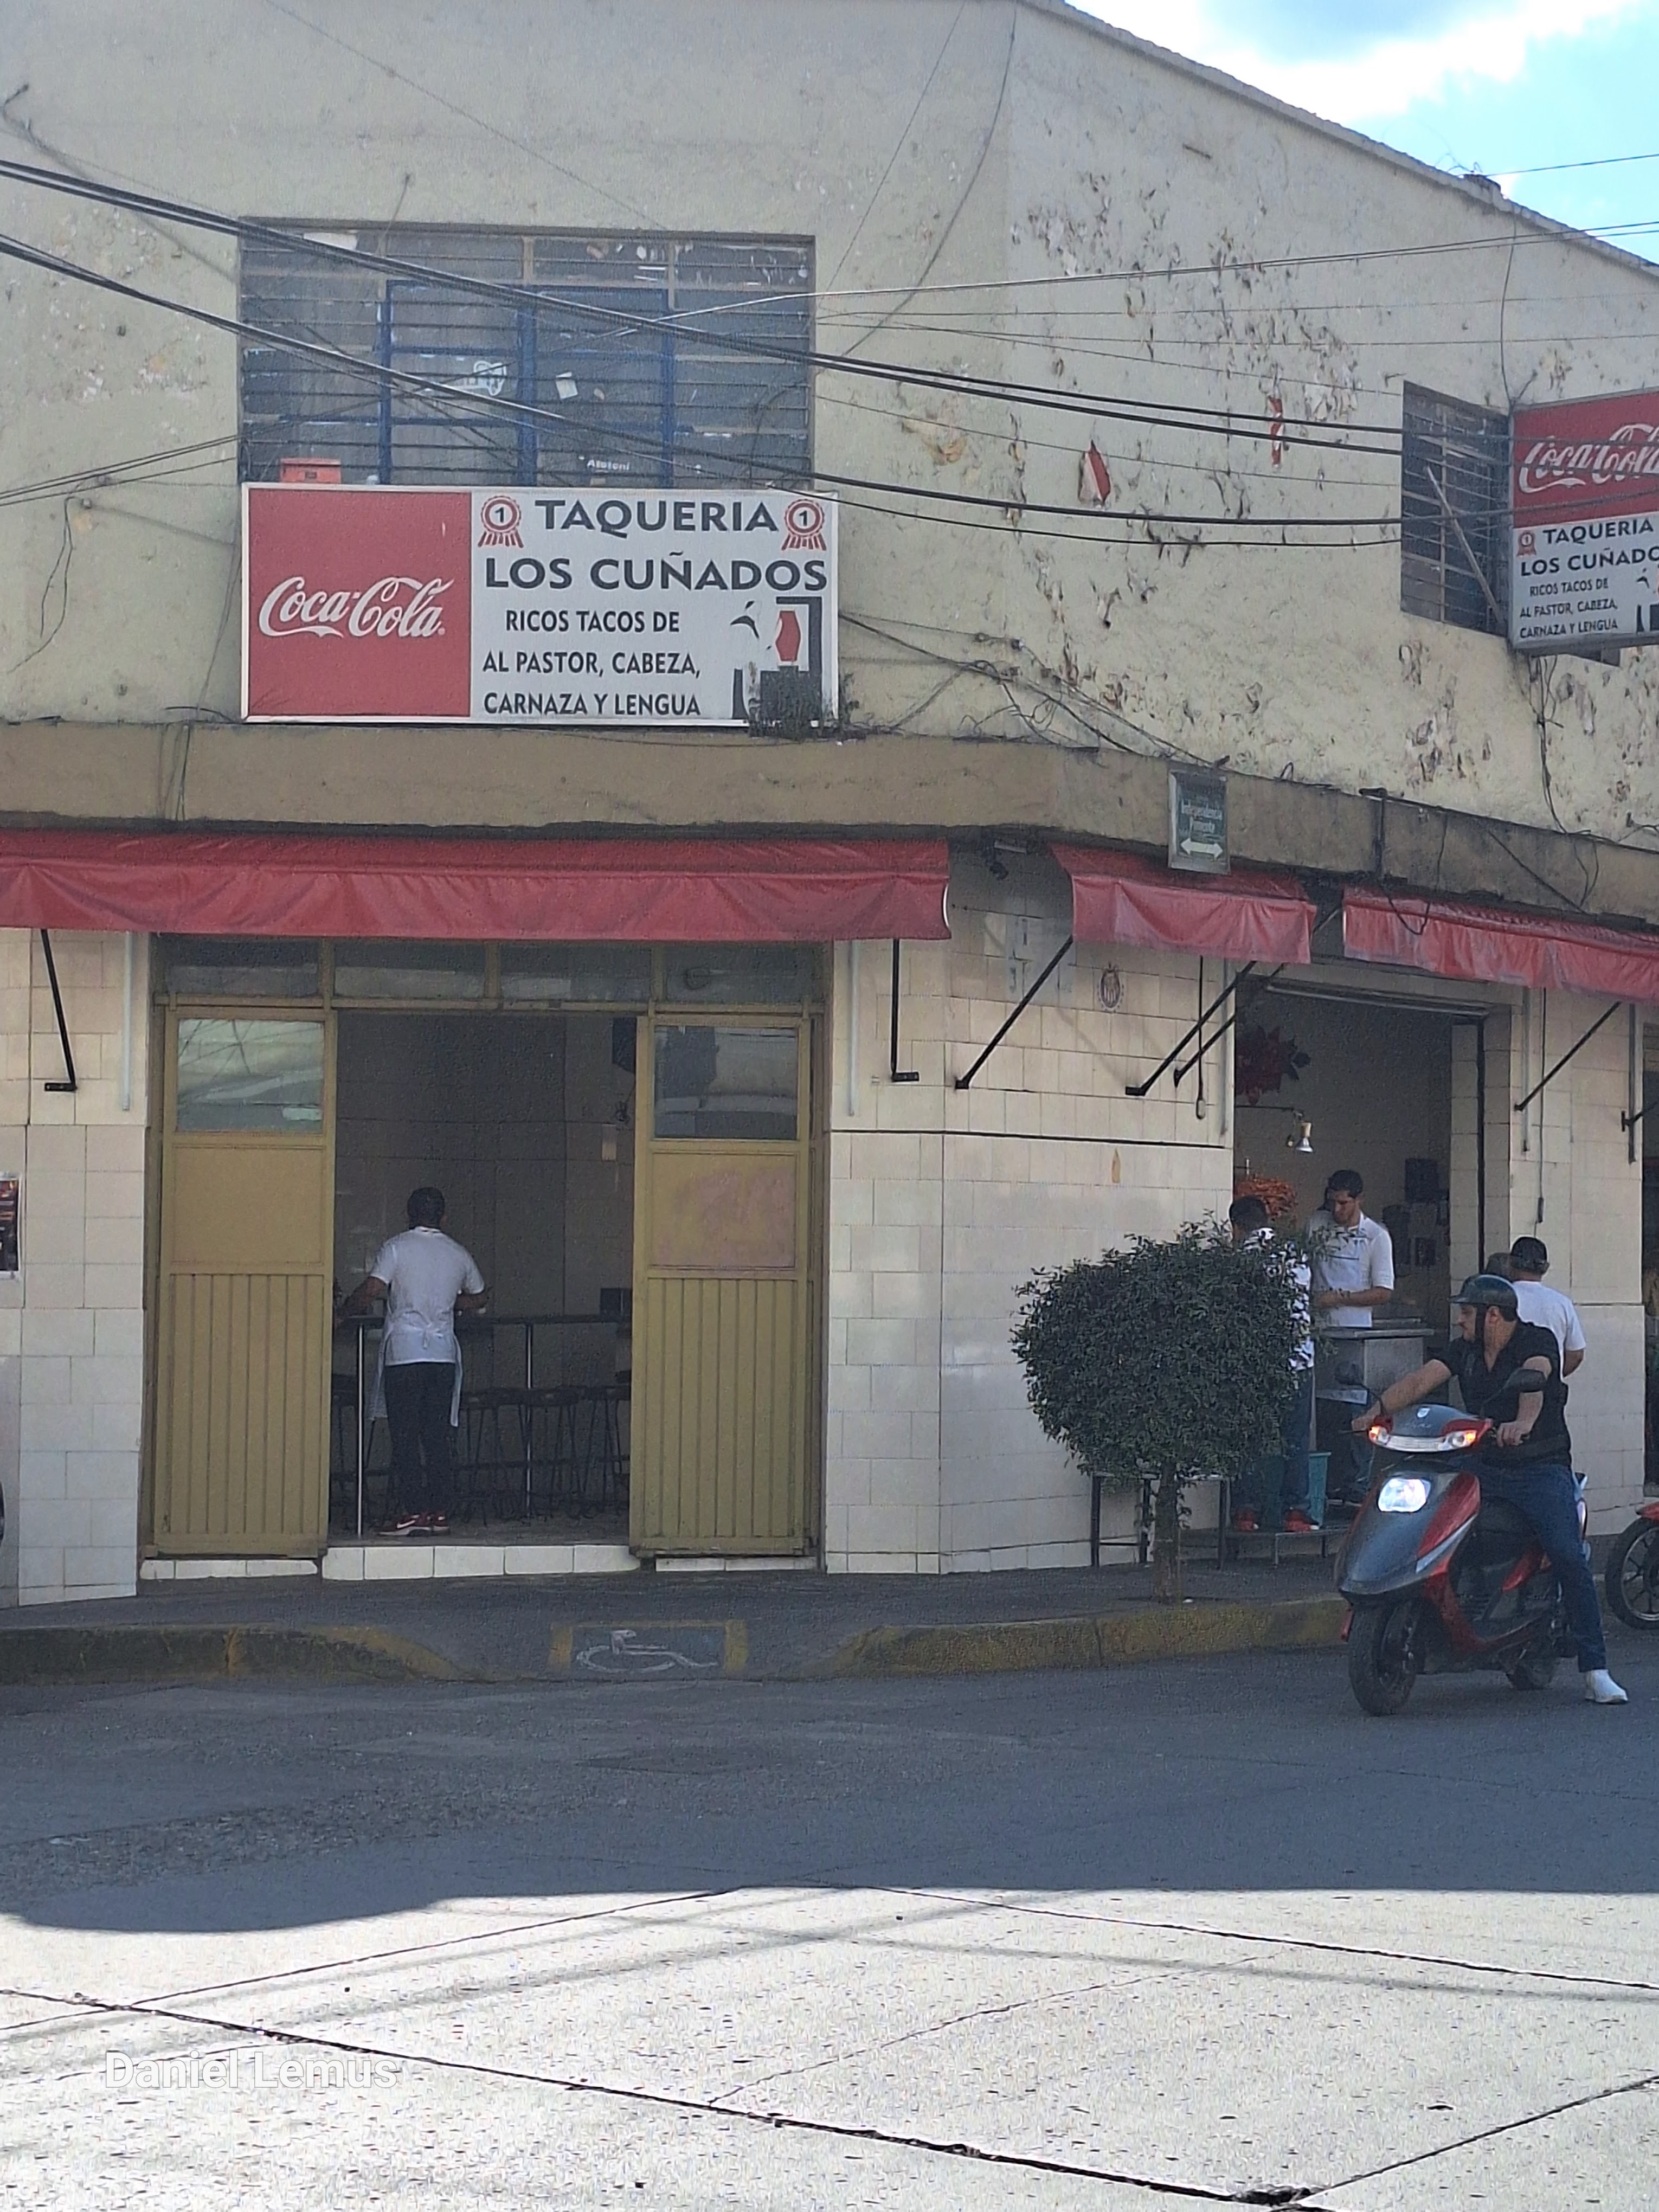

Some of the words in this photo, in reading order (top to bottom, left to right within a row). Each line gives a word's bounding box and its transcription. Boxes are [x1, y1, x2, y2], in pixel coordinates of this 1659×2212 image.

[495, 507, 504, 523] 1
[535, 500, 779, 538] TAQUERIA
[799, 510, 807, 526] 1
[1543, 519, 1654, 544] TAQUERIA
[486, 558, 573, 589] LOS
[590, 552, 827, 591] CUÑADOS
[1521, 557, 1560, 576] LOS
[1530, 583, 1558, 597] RICOS
[1561, 578, 1592, 593] TACOS
[1596, 577, 1609, 590] DE
[259, 576, 455, 638] Coca-Cola
[1520, 607, 1532, 618] AL
[506, 610, 569, 632] RICOS
[576, 610, 645, 633] TACOS
[653, 611, 679, 632] DE
[1520, 624, 1566, 639] CARNAZA
[1570, 623, 1575, 634] Y
[1578, 619, 1618, 633] LENGUA
[483, 651, 509, 672] AL
[517, 651, 603, 677] PASTOR,
[612, 652, 701, 678] CABEZA,
[484, 692, 588, 716] CARNAZA
[594, 693, 608, 715] Y
[615, 693, 701, 716] LENGUA
